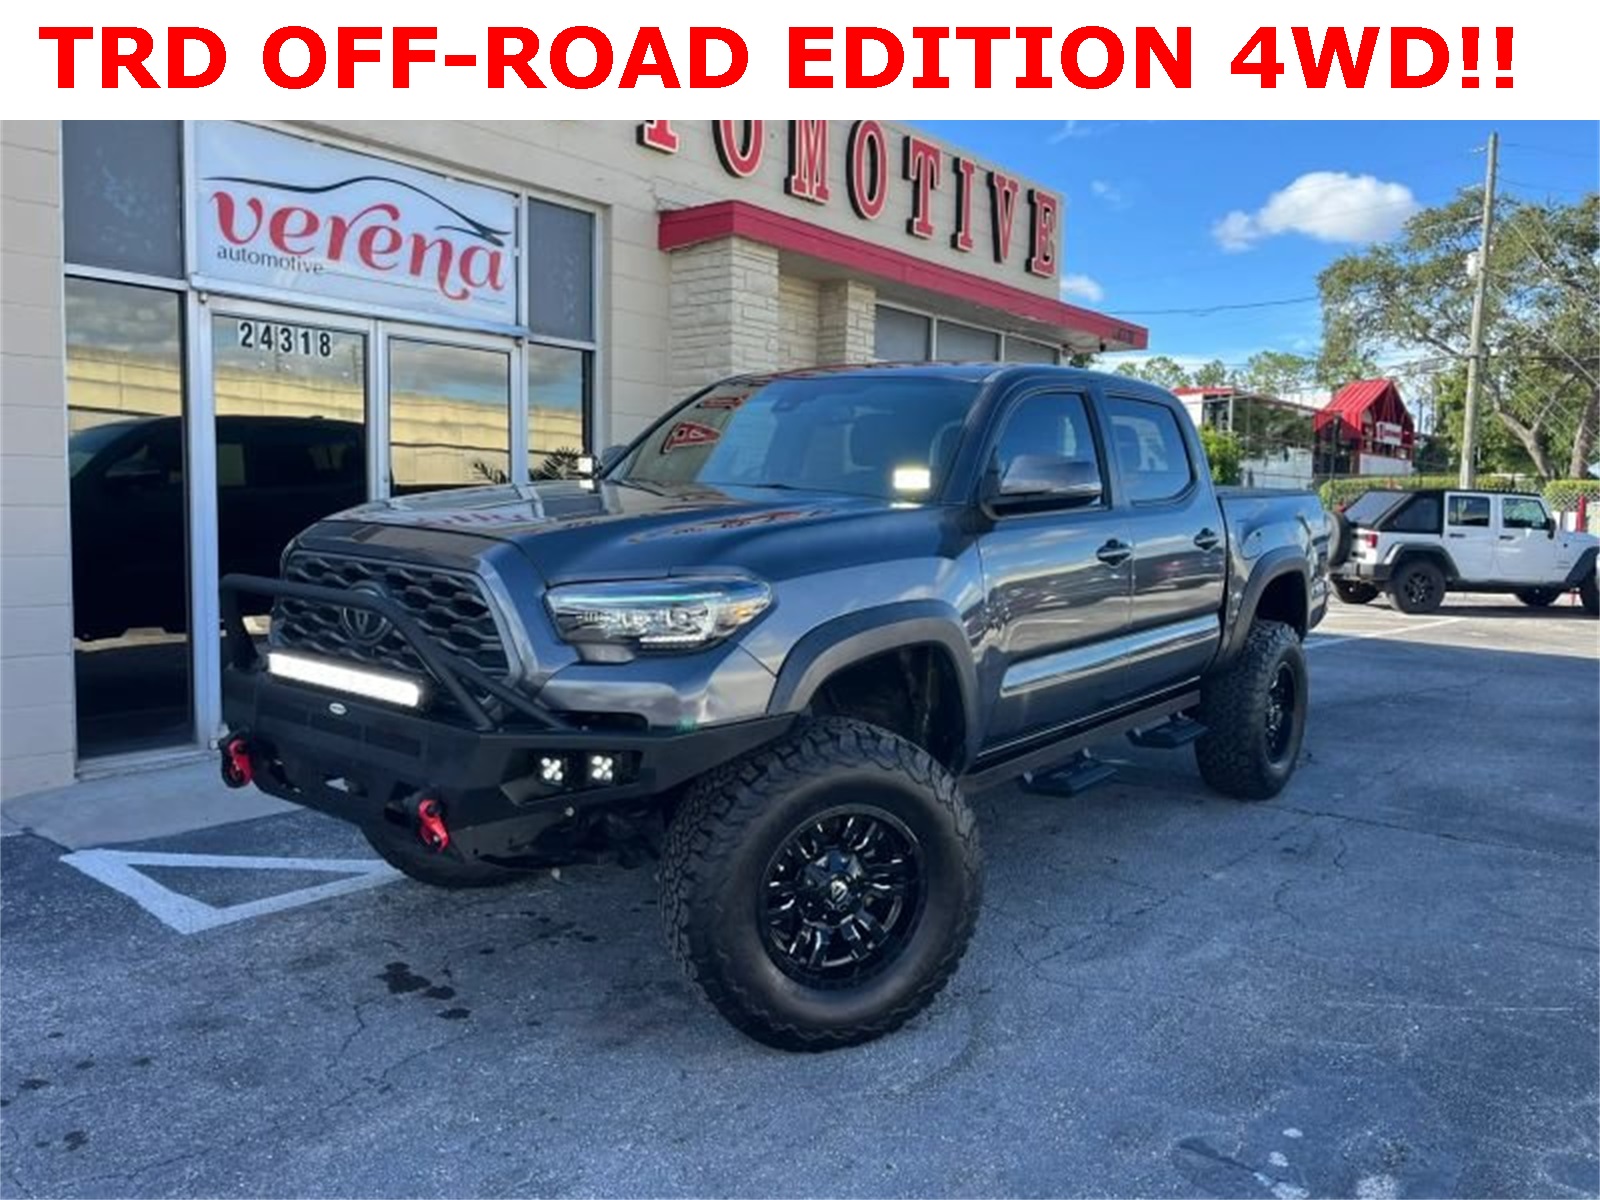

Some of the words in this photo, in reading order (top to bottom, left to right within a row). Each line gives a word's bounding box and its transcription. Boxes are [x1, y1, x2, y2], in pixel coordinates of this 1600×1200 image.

[211, 190, 505, 300] verena
[217, 244, 324, 276] automotive
[239, 321, 332, 357] 24318
